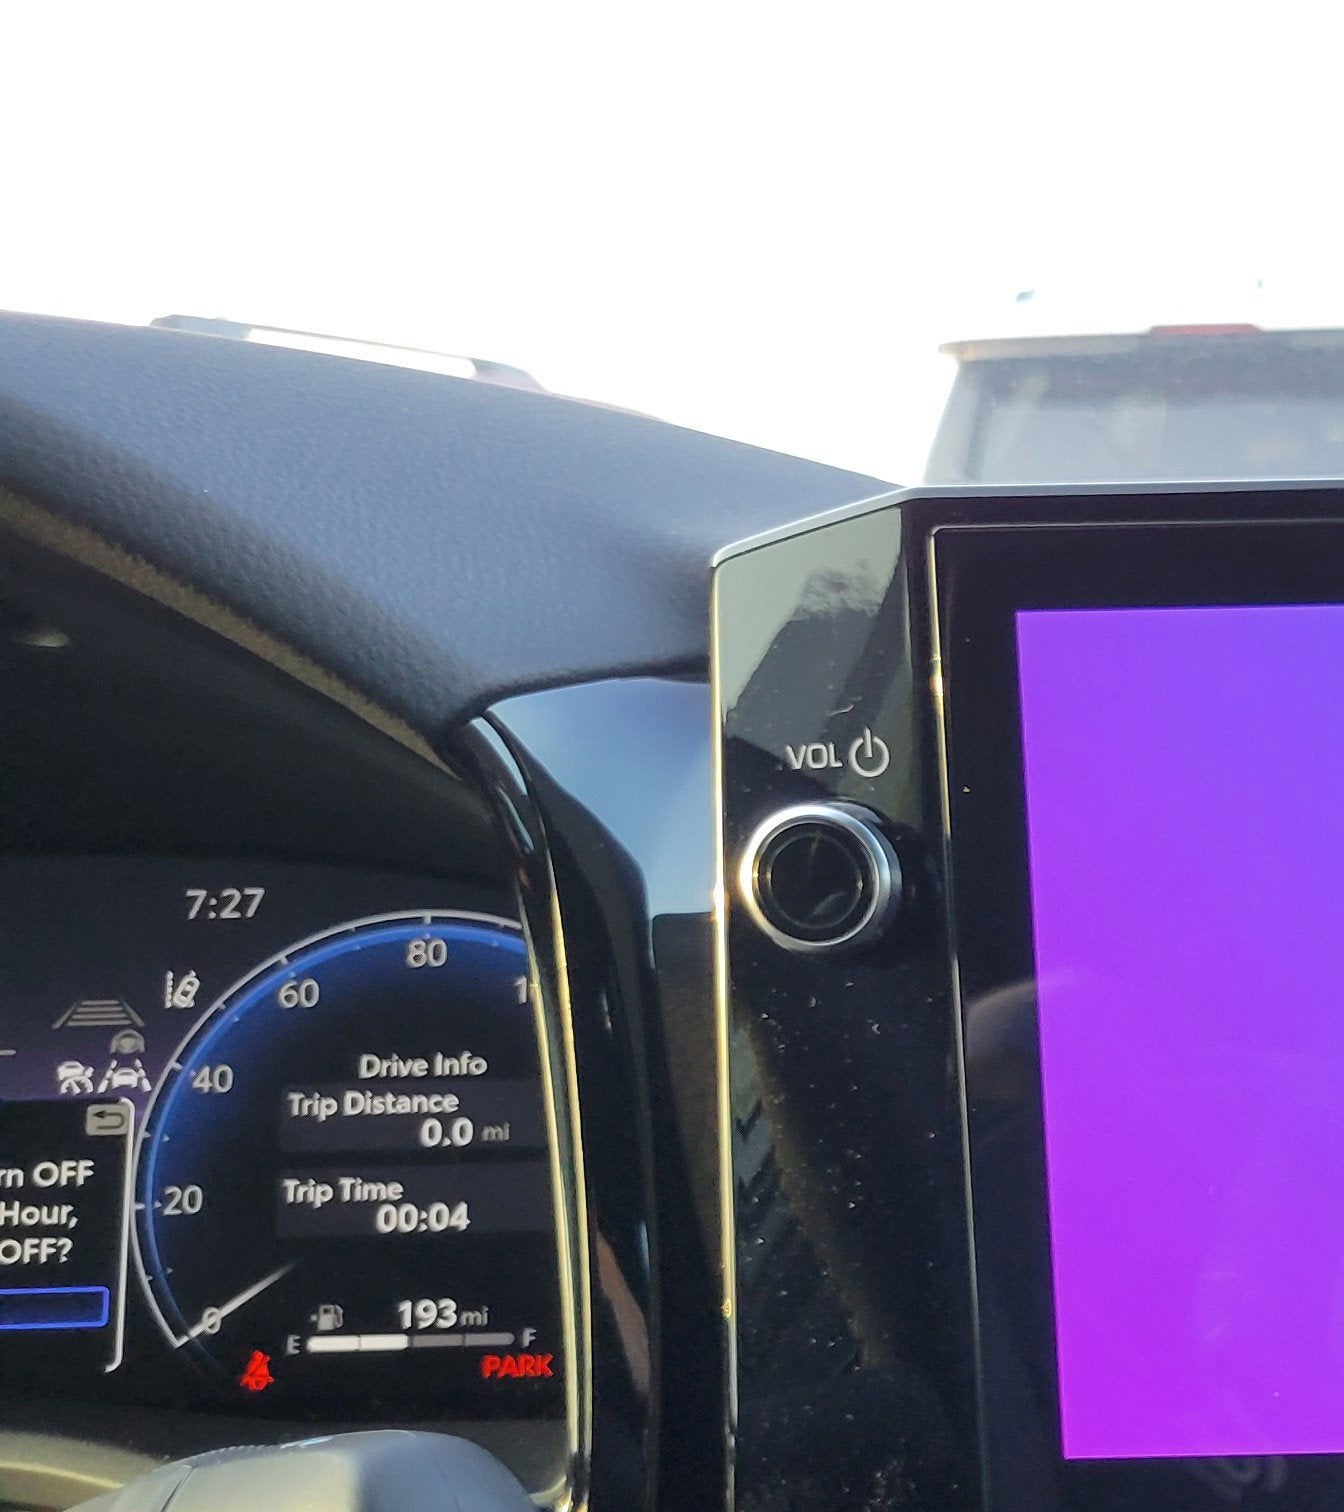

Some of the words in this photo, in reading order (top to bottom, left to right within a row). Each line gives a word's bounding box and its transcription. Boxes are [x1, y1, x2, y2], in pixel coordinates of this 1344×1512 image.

[785, 742, 843, 770] VOL
[185, 887, 265, 920] 7:27
[406, 938, 448, 968] 80
[278, 978, 320, 1008] 60
[191, 1064, 234, 1093] 40
[359, 1054, 428, 1079] Drive
[434, 1050, 488, 1076] Info
[288, 1091, 337, 1121] Trip
[343, 1089, 459, 1115] Distance
[420, 1119, 474, 1147] 0.0
[482, 1123, 510, 1141] mi
[32, 1160, 95, 1188] OFF
[164, 1184, 203, 1216] 20
[282, 1178, 333, 1208] Trip
[339, 1176, 404, 1202] Time
[0, 1200, 79, 1229] Hour,
[376, 1201, 470, 1234] 00:04
[0, 1237, 73, 1265] OFF?
[397, 1299, 458, 1329] 193
[459, 1305, 489, 1327] mi
[286, 1334, 301, 1356] E
[521, 1327, 539, 1348] F
[481, 1354, 554, 1379] PARK
